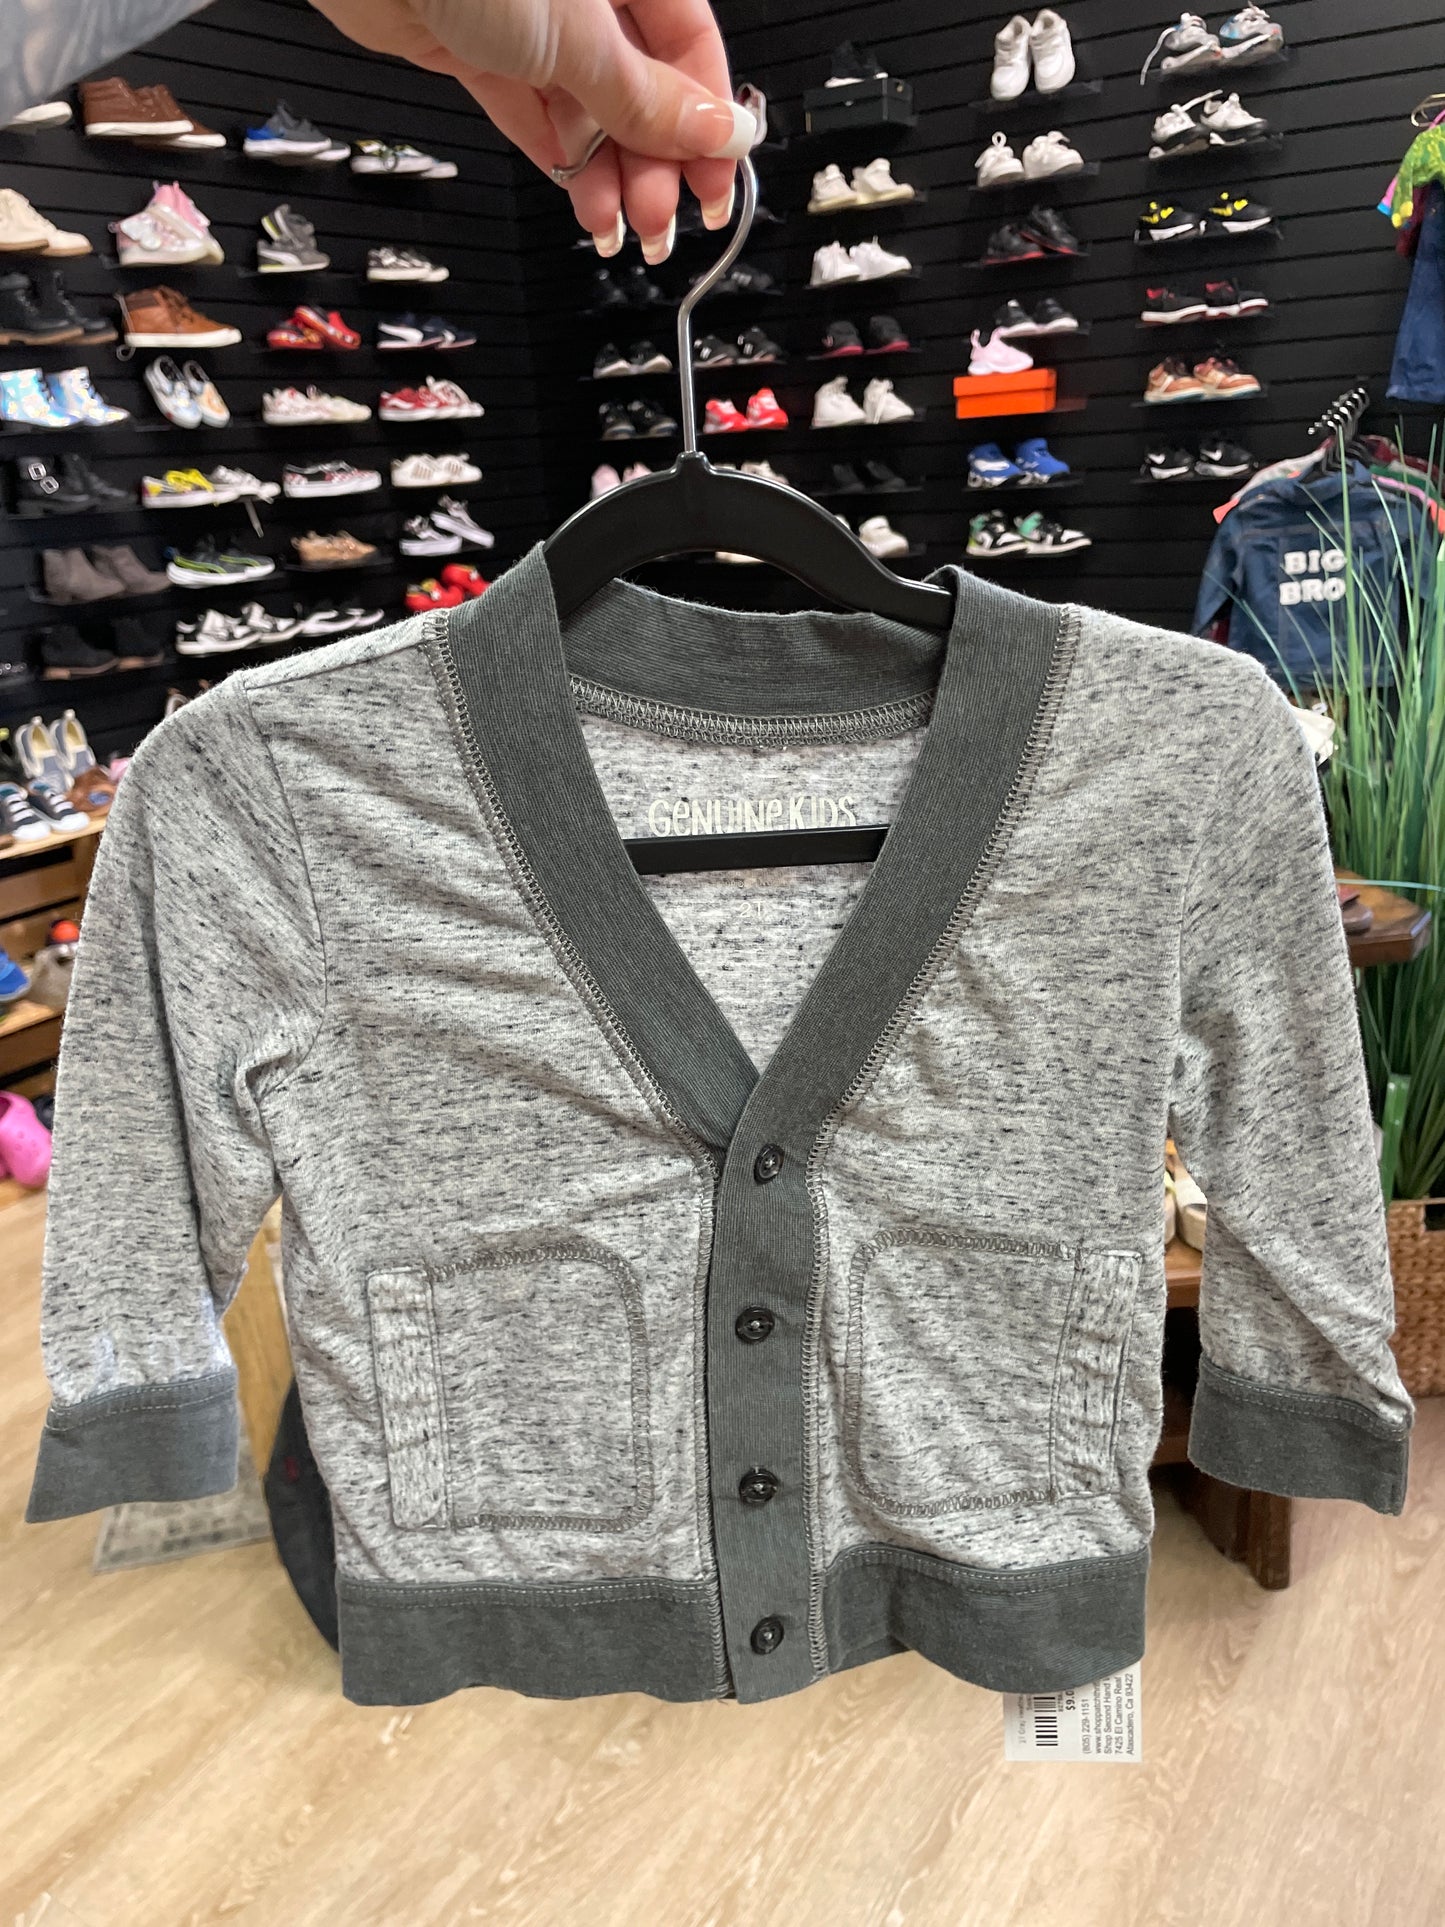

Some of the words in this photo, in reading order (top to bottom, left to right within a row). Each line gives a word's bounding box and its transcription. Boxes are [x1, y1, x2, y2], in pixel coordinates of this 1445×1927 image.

[1284, 549, 1347, 575] BIG
[1280, 577, 1346, 605] BRO
[790, 796, 857, 830] KIDS
[1103, 1683, 1111, 1703] Hand
[1125, 1673, 1133, 1696] 93422
[1081, 1699, 1090, 1733] 229-1151
[1114, 1696, 1123, 1725] Camino
[1125, 1699, 1133, 1709] Ca
[1103, 1705, 1112, 1733] Second
[1114, 1727, 1123, 1735] El
[1104, 1735, 1112, 1754] Shop
[1114, 1736, 1123, 1754] 7425
